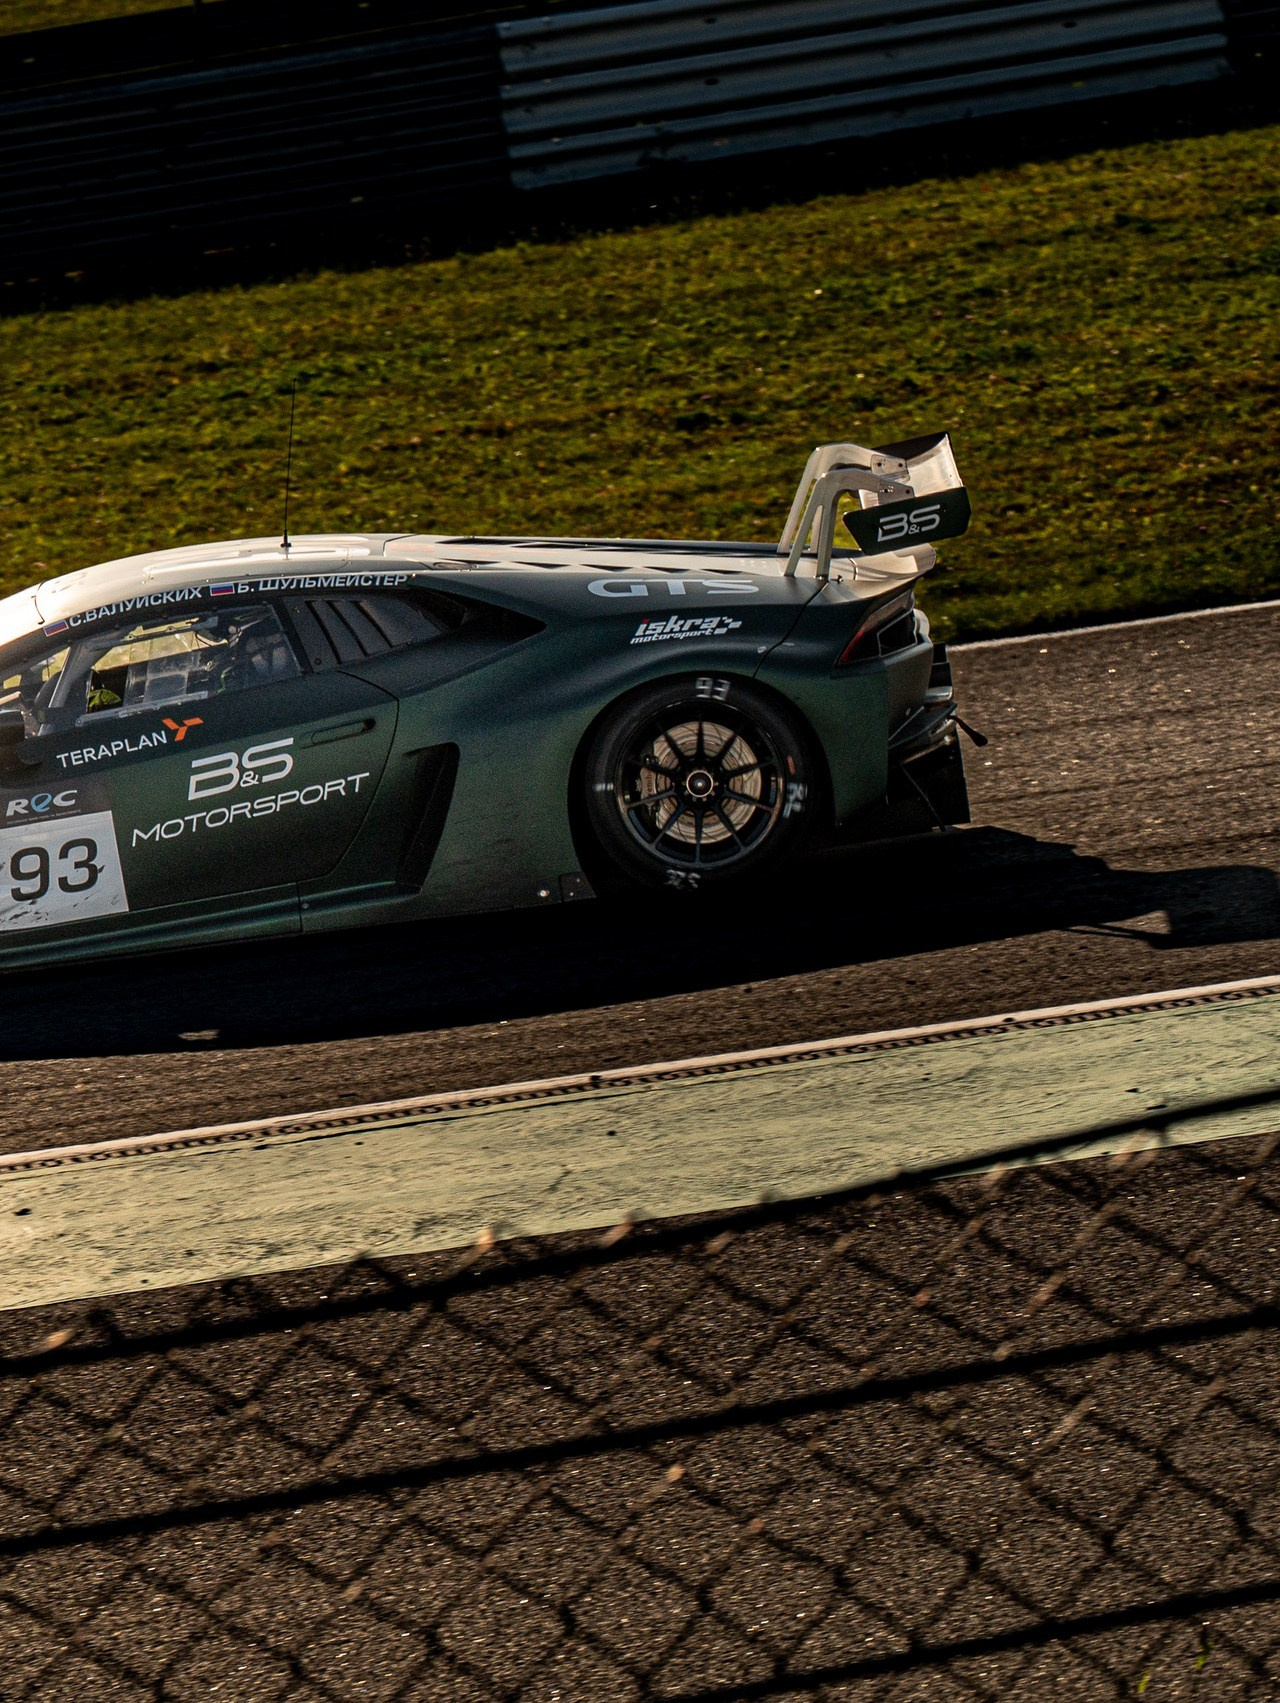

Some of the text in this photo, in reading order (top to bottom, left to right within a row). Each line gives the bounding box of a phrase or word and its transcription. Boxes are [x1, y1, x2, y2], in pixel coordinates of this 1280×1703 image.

[877, 504, 941, 543] B&S
[587, 578, 760, 598] GTS
[630, 628, 715, 645] motorsport
[56, 730, 167, 769] TERAPLAN
[188, 737, 294, 801] B&S
[132, 772, 370, 848] MOTORSPORT
[9, 837, 99, 902] 93
